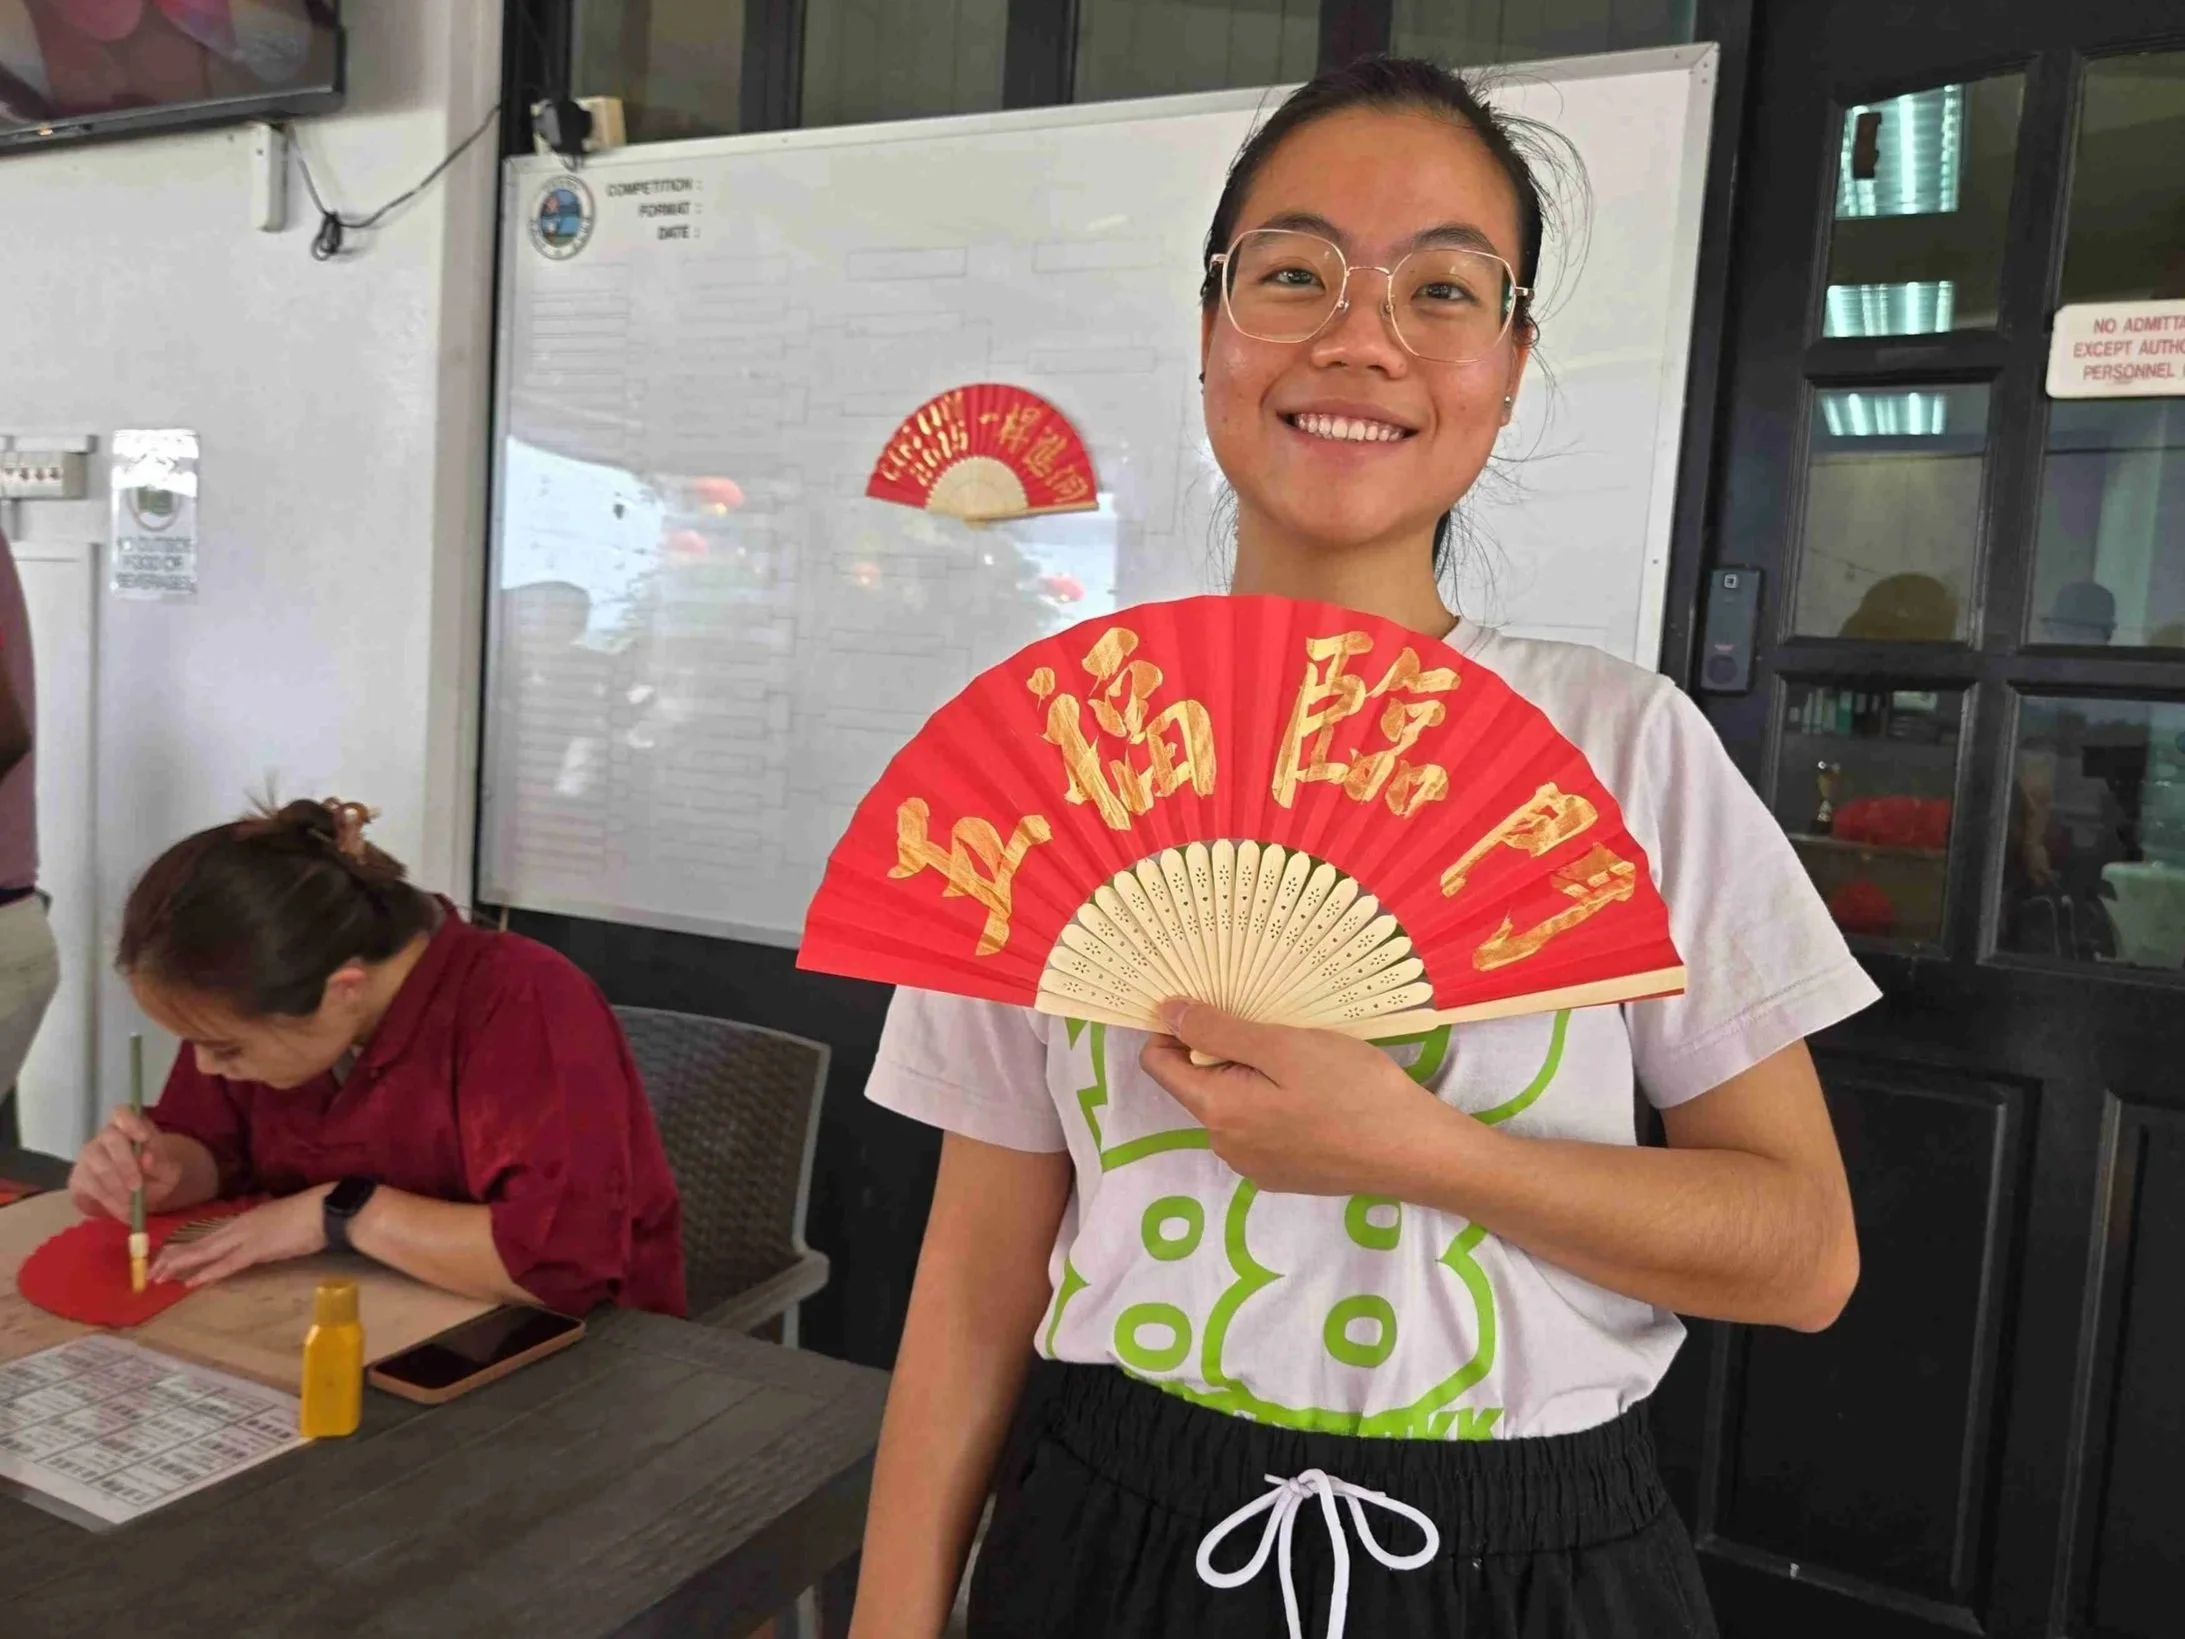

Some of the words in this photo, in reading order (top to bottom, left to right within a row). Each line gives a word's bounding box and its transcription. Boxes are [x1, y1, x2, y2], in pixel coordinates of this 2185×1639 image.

[606, 178, 693, 197] COMPETITION
[639, 202, 690, 217] FORMAT
[658, 225, 688, 240] DATE
[2093, 318, 2117, 334] NO
[2073, 340, 2132, 358] EXCEPT
[2083, 362, 2175, 380] PERSONNEL
[887, 626, 1637, 972] 五福臨門
